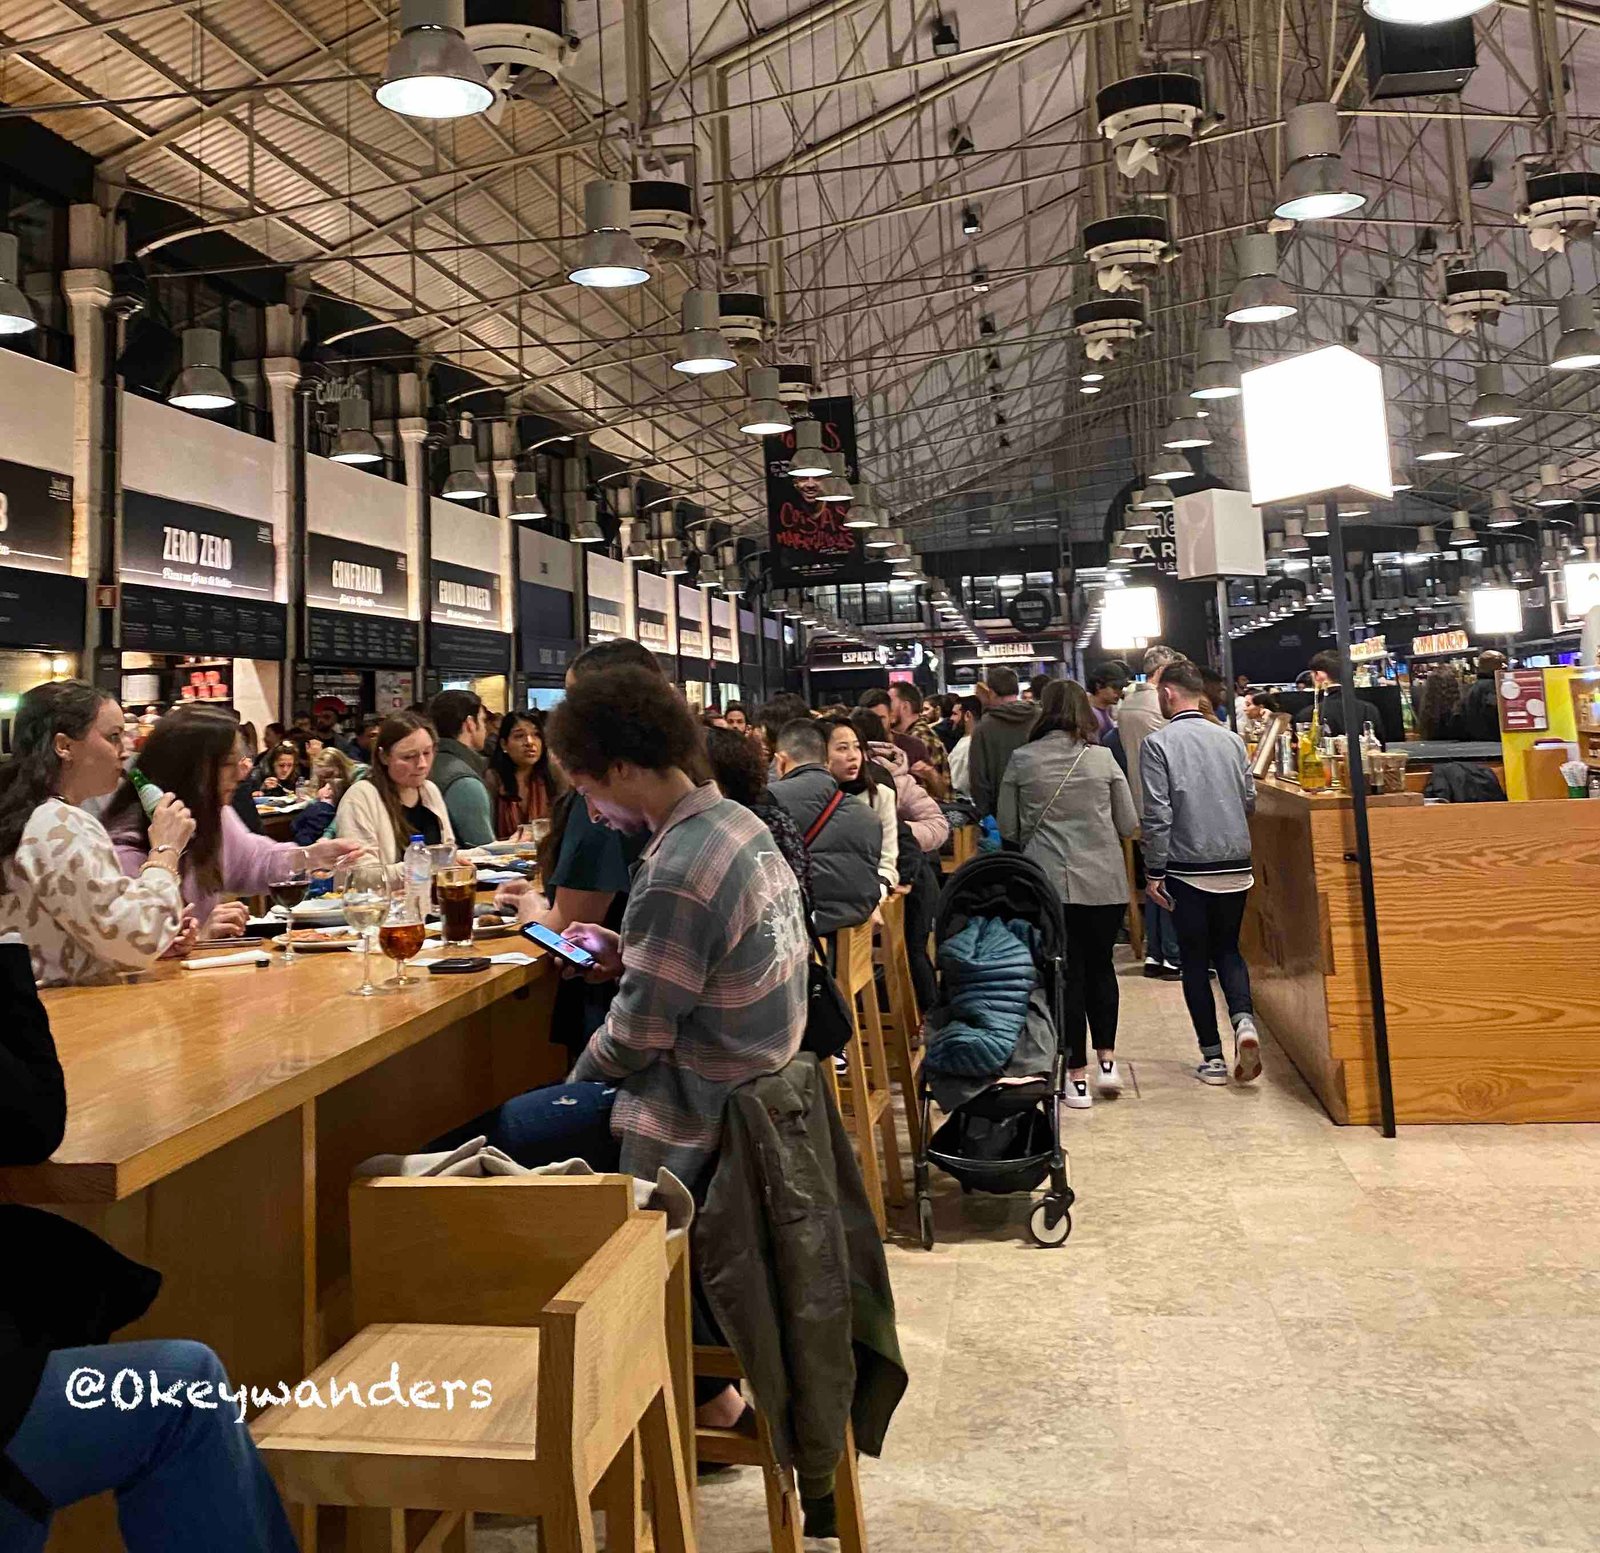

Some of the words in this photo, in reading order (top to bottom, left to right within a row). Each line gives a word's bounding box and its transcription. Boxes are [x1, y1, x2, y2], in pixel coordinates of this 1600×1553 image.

[162, 526, 198, 564] ZERO
[200, 533, 232, 570] ZERO
[331, 560, 383, 594] CONFRARIA
